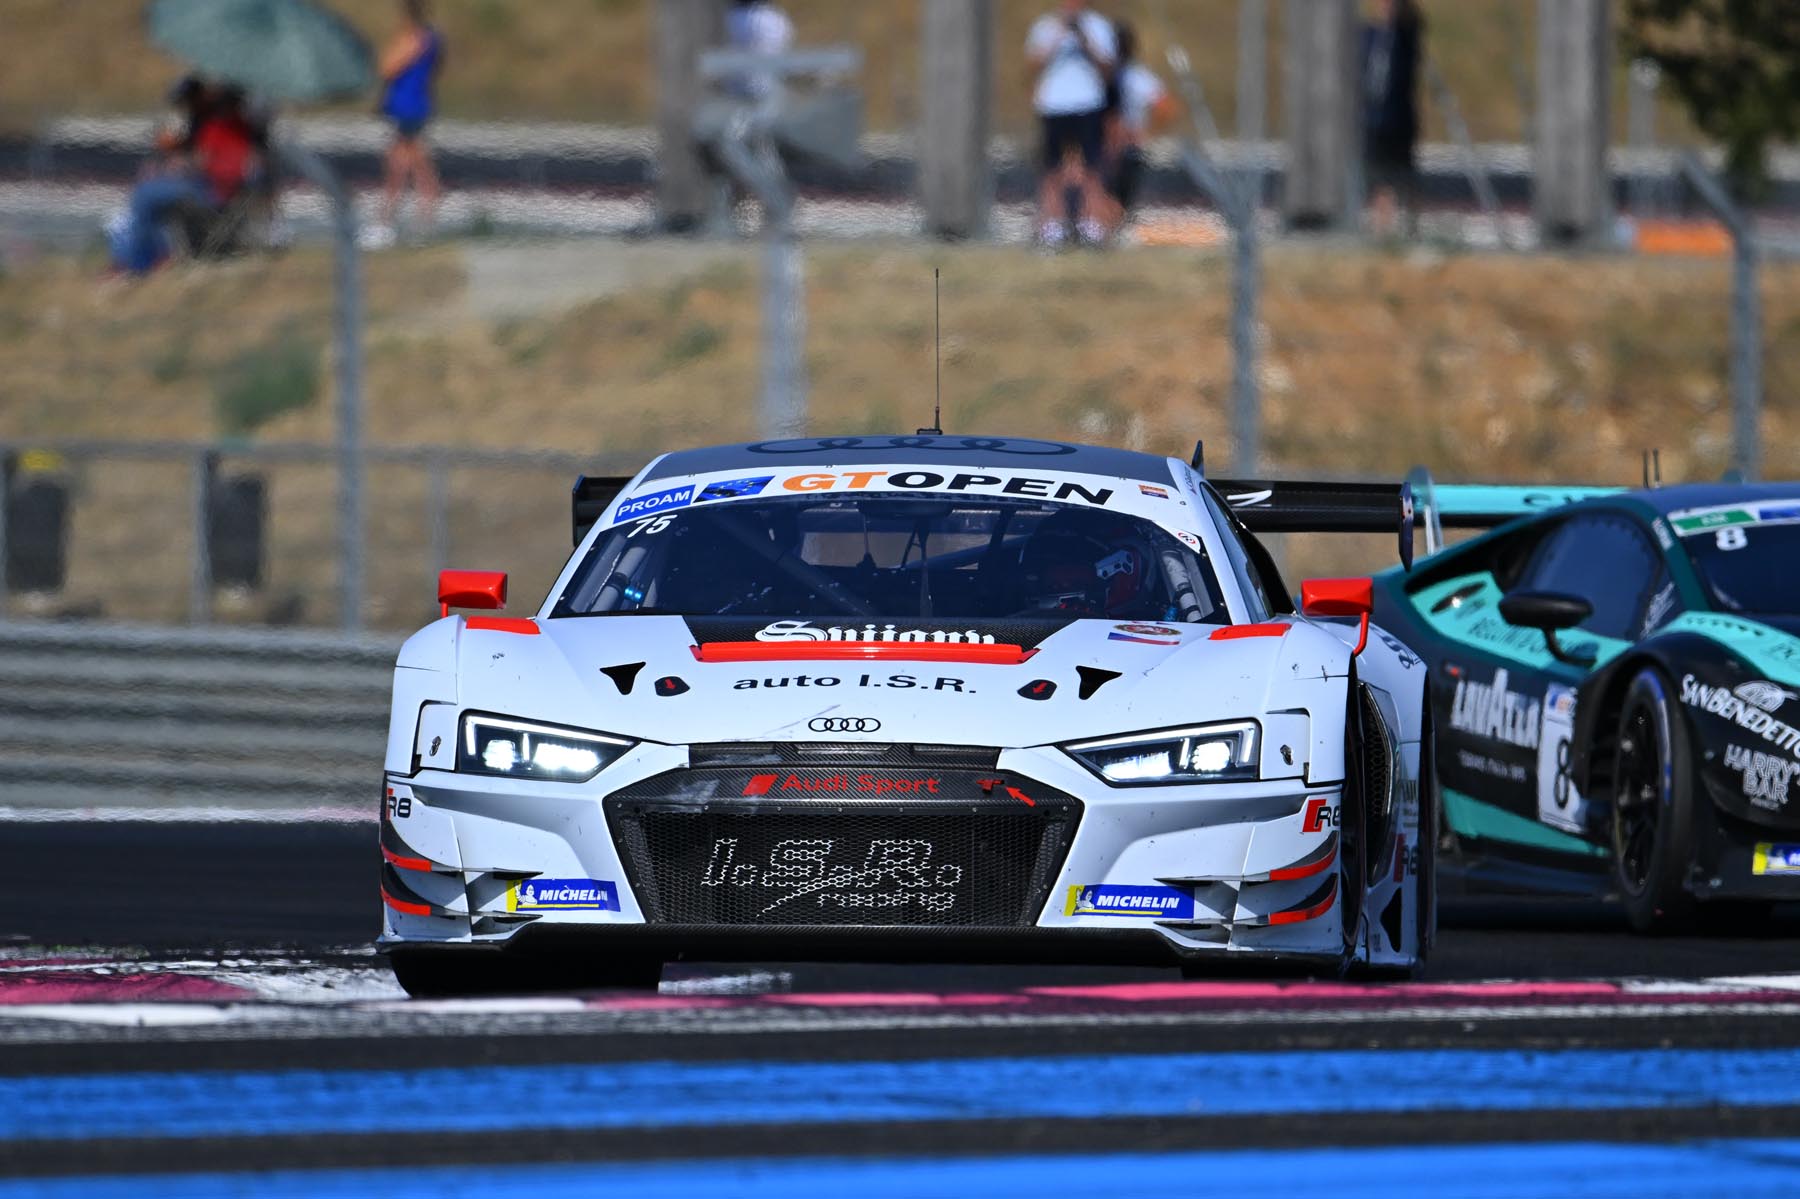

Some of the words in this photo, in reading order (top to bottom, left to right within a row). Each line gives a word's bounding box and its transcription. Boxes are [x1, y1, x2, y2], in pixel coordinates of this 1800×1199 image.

[617, 489, 691, 517] PROAM
[627, 514, 678, 538] 75
[1716, 526, 1748, 551] 8
[733, 675, 841, 690] auto
[859, 674, 977, 694] I.S.R.
[780, 774, 848, 791] Audi
[857, 774, 940, 795] Sport
[1555, 738, 1570, 811] 8
[539, 888, 608, 902] MICHELIN
[1096, 895, 1180, 909] MICHELIN
